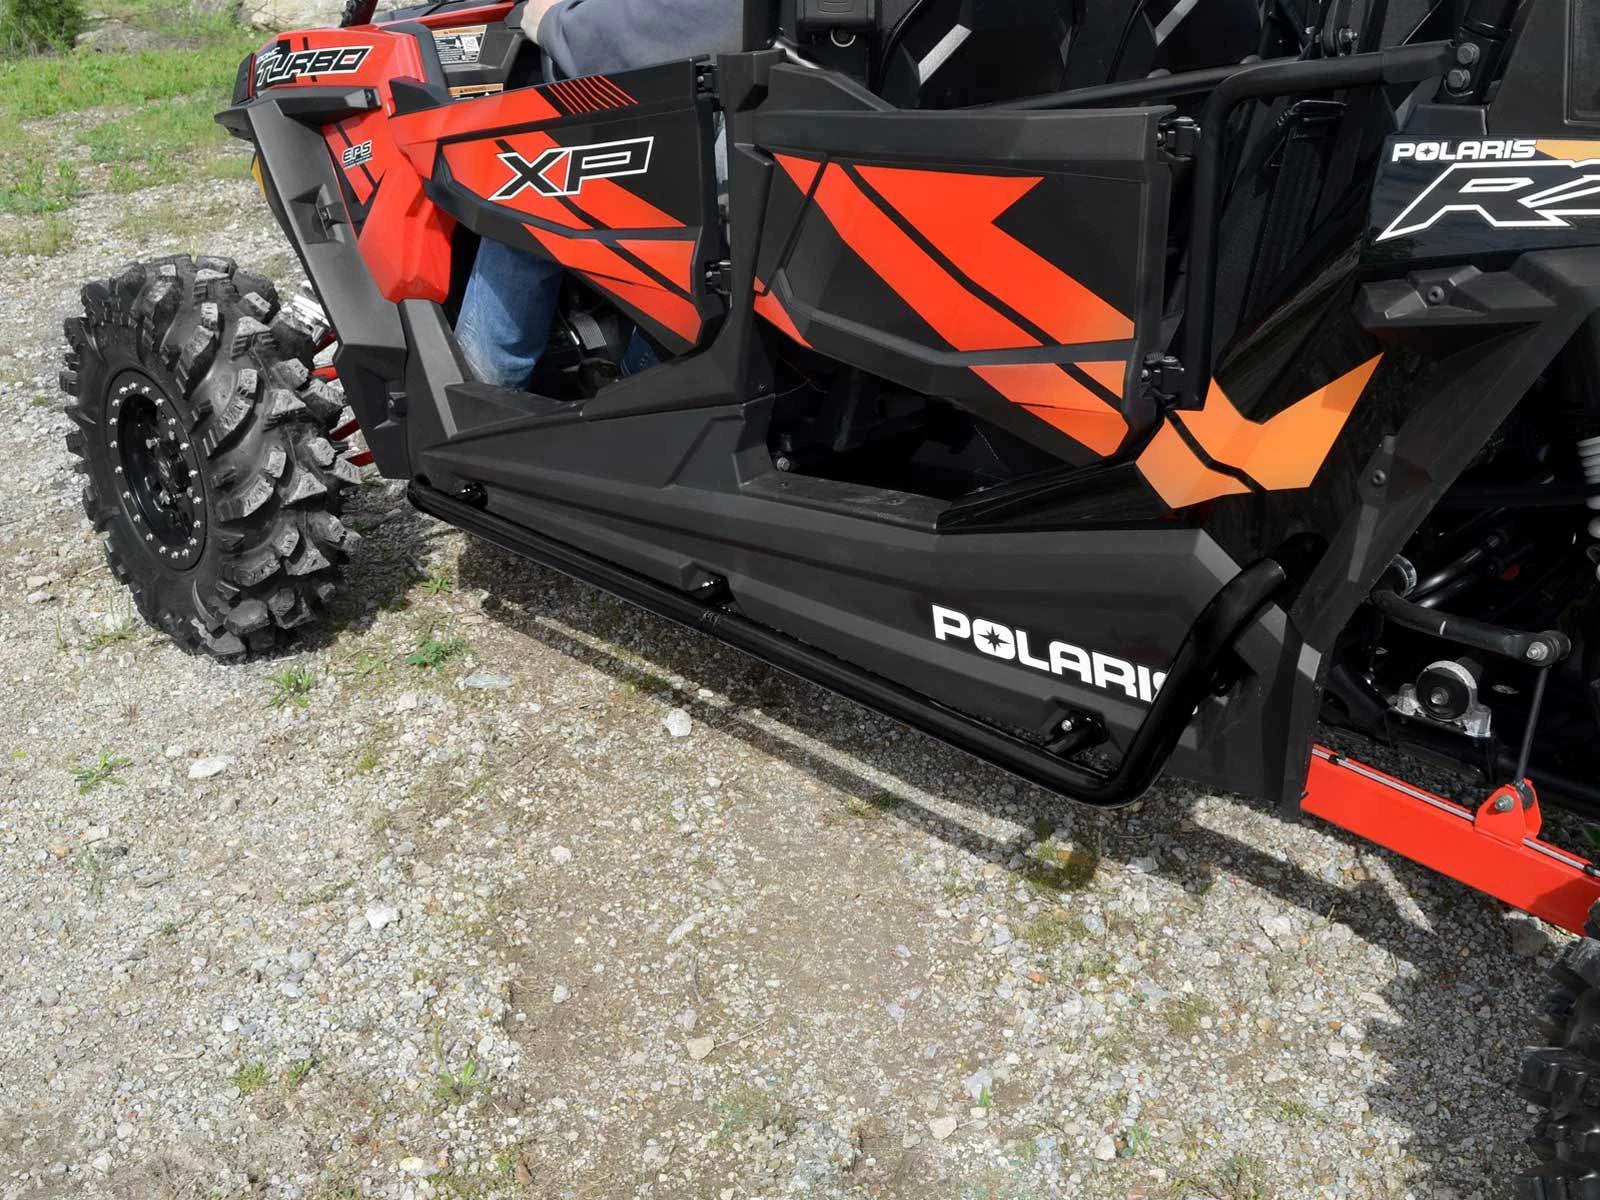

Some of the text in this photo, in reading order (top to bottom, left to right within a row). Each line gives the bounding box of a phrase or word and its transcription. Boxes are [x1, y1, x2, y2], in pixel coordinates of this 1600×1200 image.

[256, 45, 374, 87] TURBO
[342, 140, 372, 163] EPS
[1391, 139, 1537, 162] POLARIS
[487, 135, 654, 201] XP
